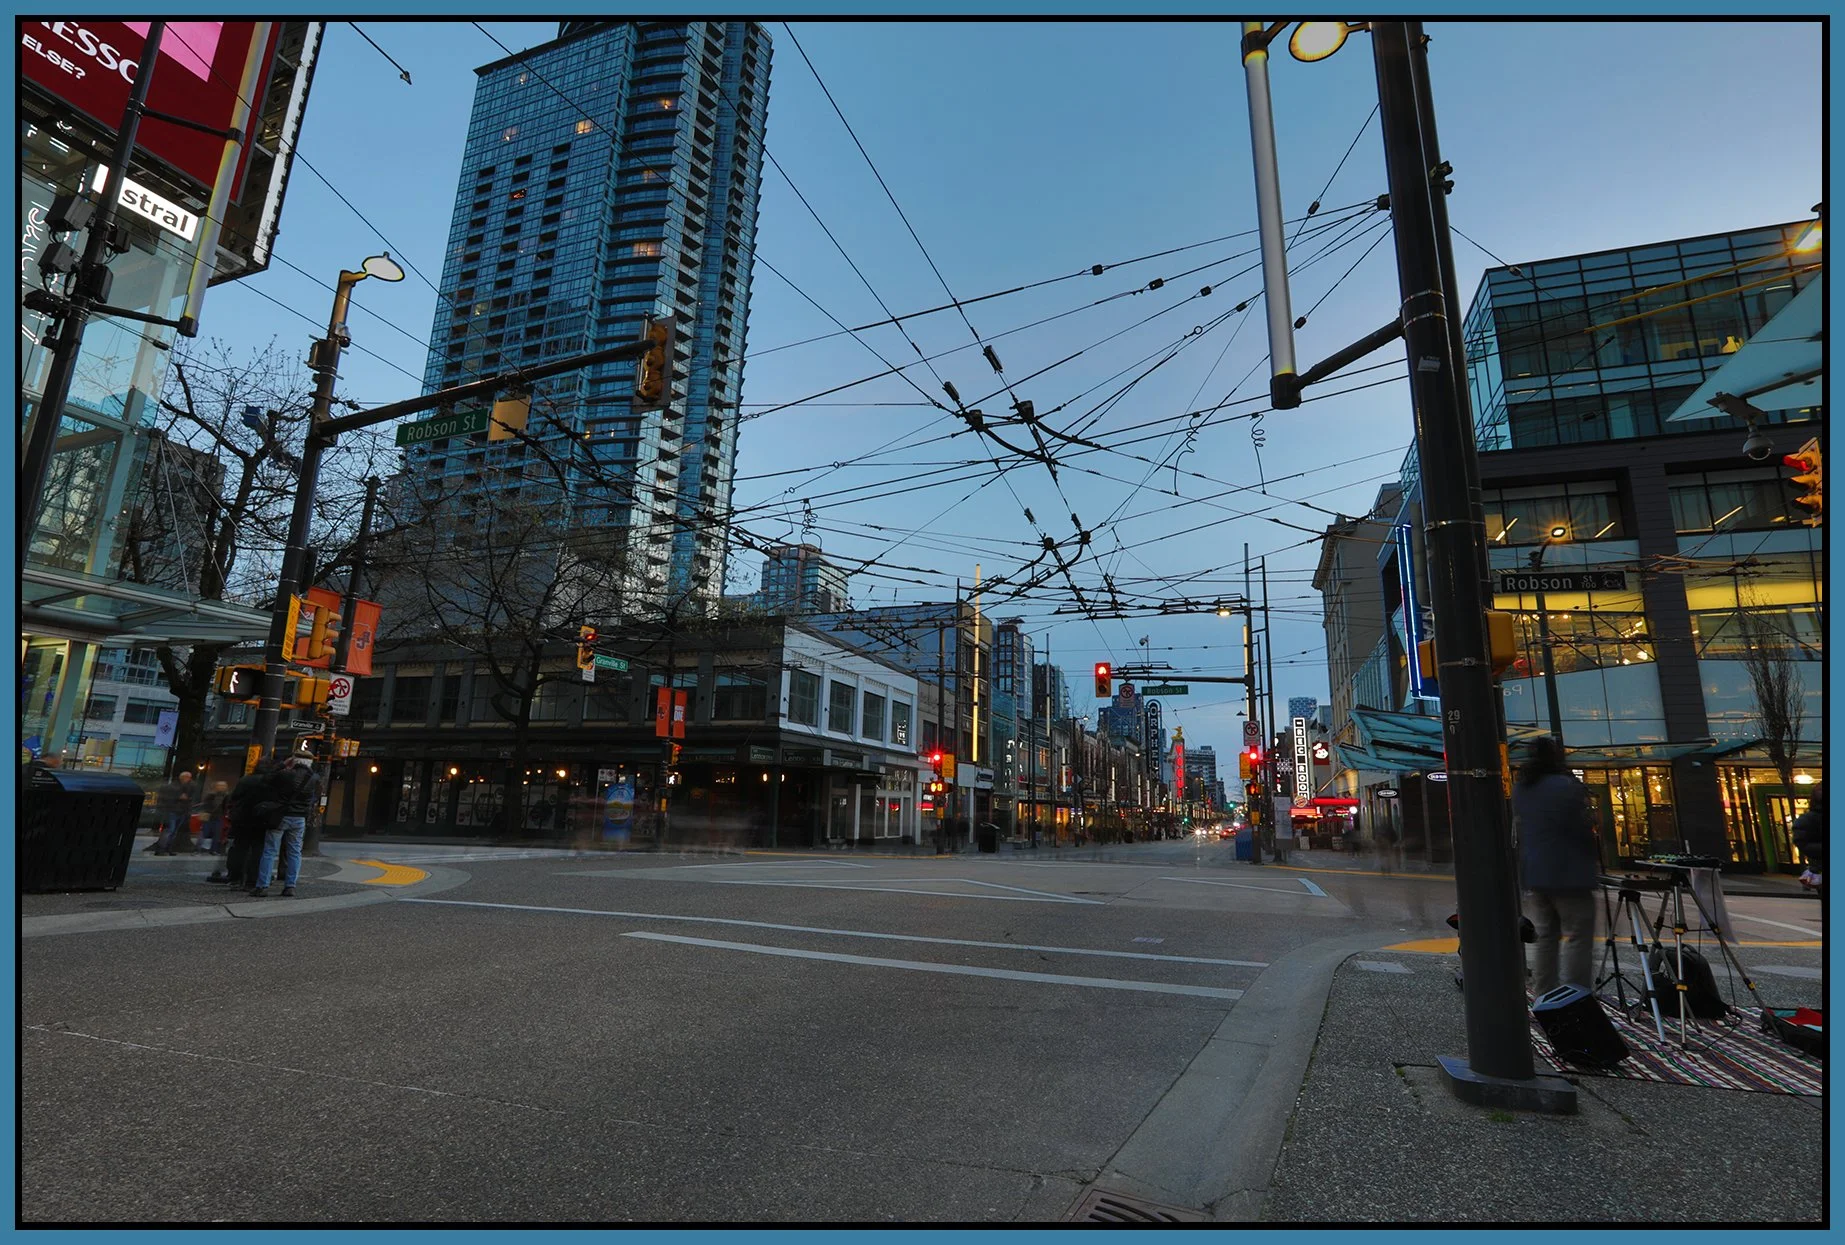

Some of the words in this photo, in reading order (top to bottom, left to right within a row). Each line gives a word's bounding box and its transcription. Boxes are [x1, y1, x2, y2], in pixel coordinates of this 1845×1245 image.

[22, 34, 86, 79] ELSE?
[407, 421, 457, 441] Robson
[463, 414, 477, 431] St
[1506, 576, 1573, 590] Robson
[596, 656, 619, 669] Granville
[1147, 686, 1173, 695] Robson
[1175, 686, 1184, 694] St
[1447, 710, 1461, 721] 29
[1296, 729, 1306, 754] REC
